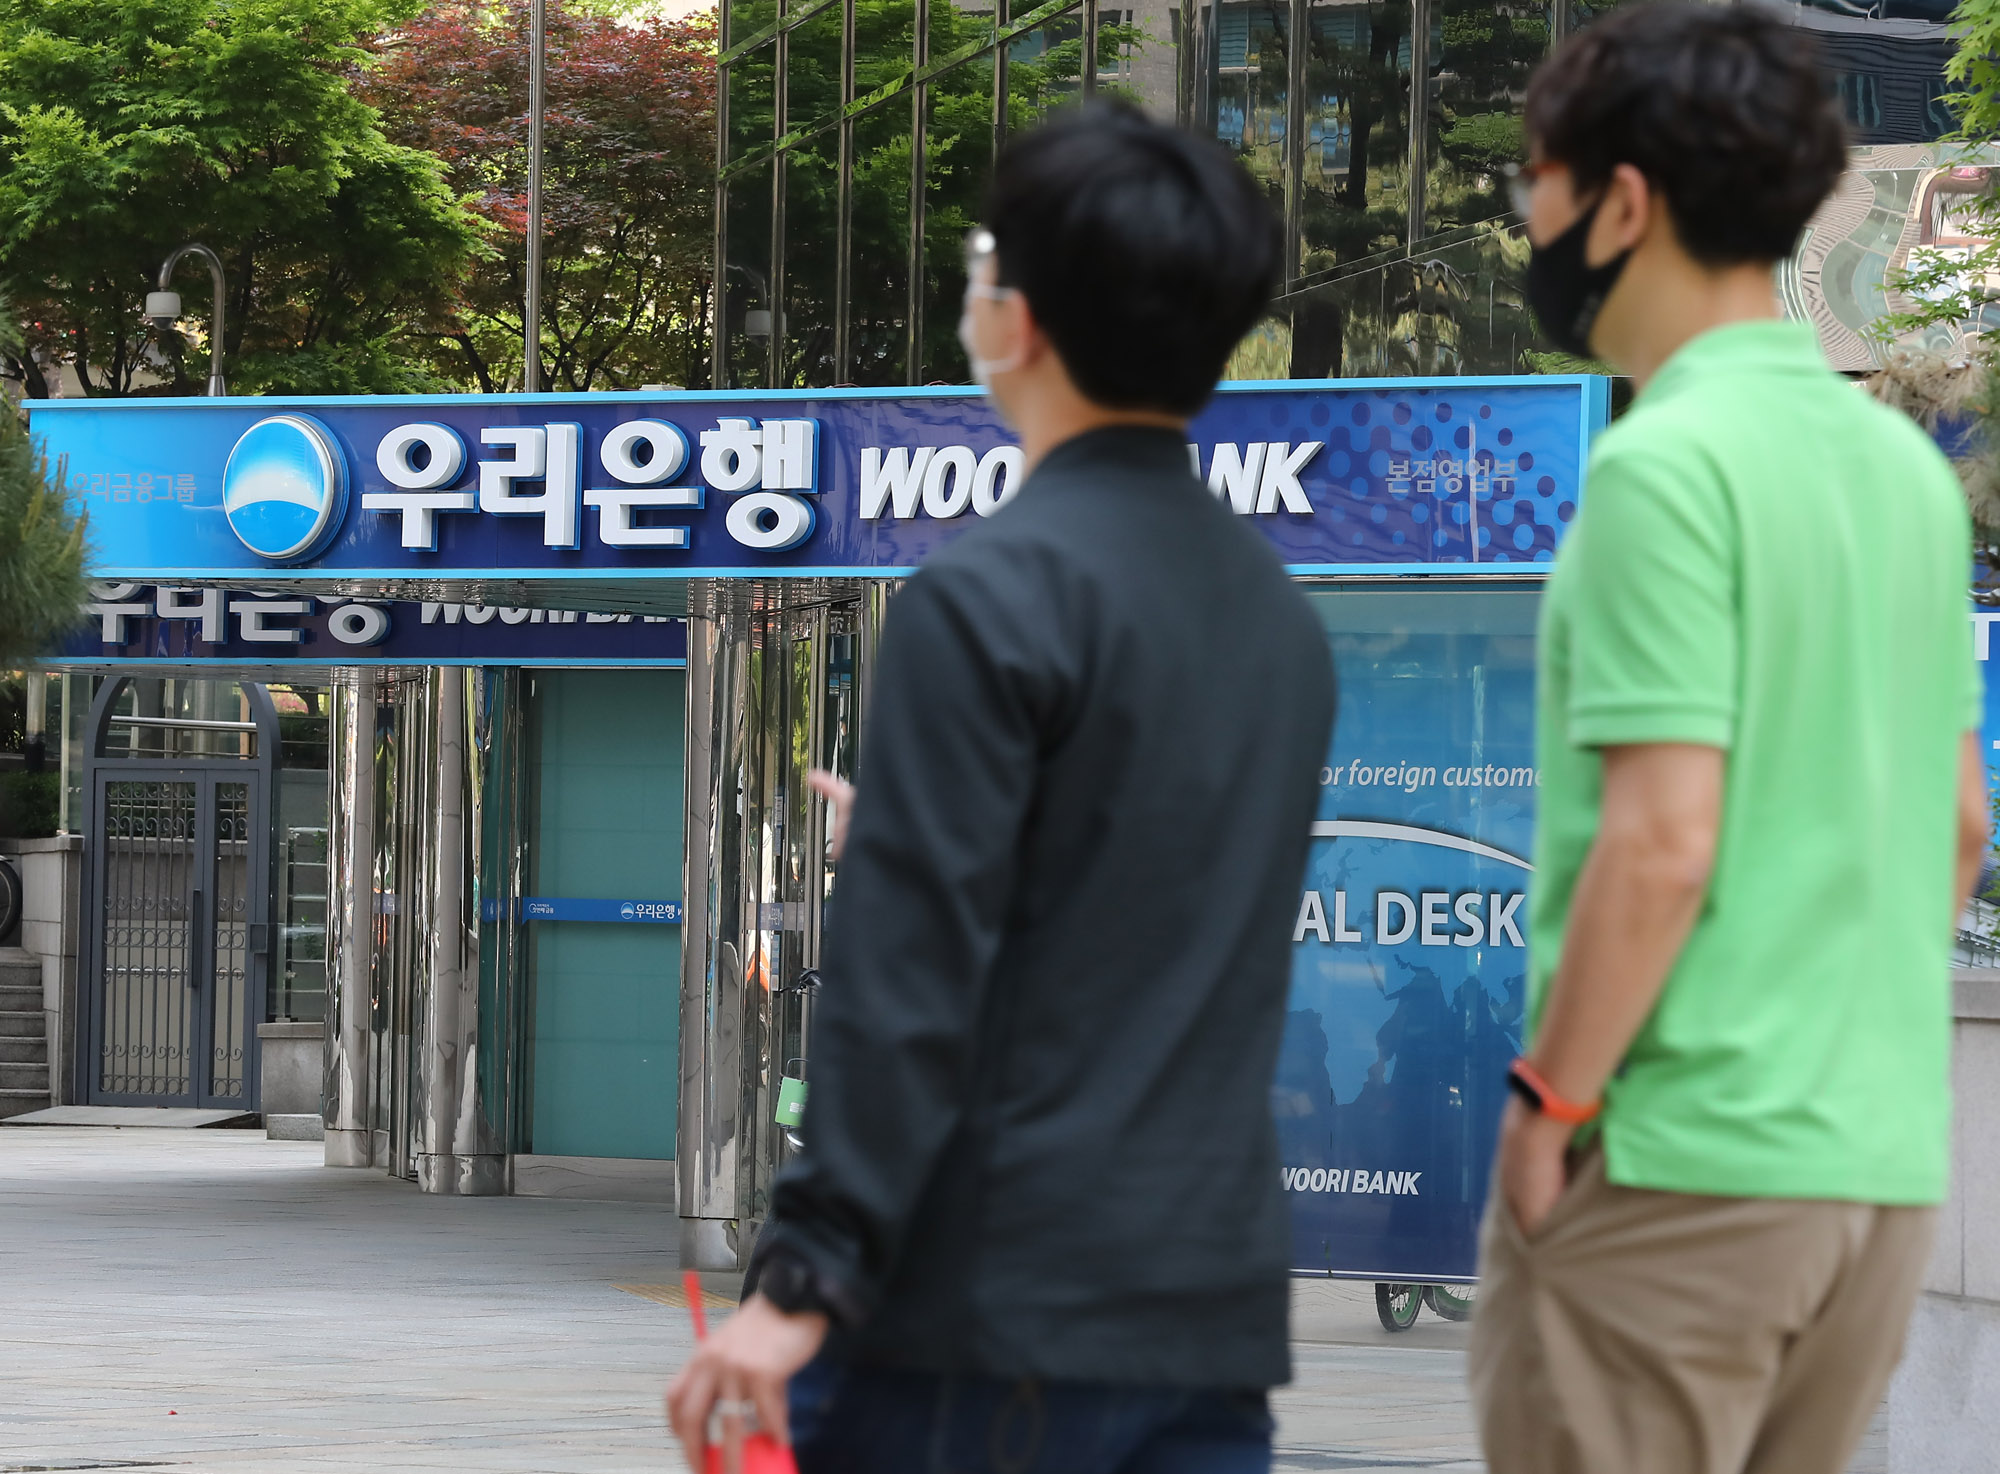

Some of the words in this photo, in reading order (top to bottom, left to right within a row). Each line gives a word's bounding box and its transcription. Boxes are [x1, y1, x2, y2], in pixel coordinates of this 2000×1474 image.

[73, 472, 197, 503] 우리금융그룹
[361, 418, 822, 552] 우리은행
[859, 445, 1027, 519] WOO
[1384, 458, 1518, 494] 본점영업부
[1319, 765, 1344, 786] or
[1349, 758, 1436, 793] foreign
[1442, 763, 1545, 787] custome
[635, 903, 676, 920] 우리은행
[1292, 890, 1362, 942] AL
[1376, 891, 1527, 947] DESK
[1352, 1169, 1423, 1196] BANK
